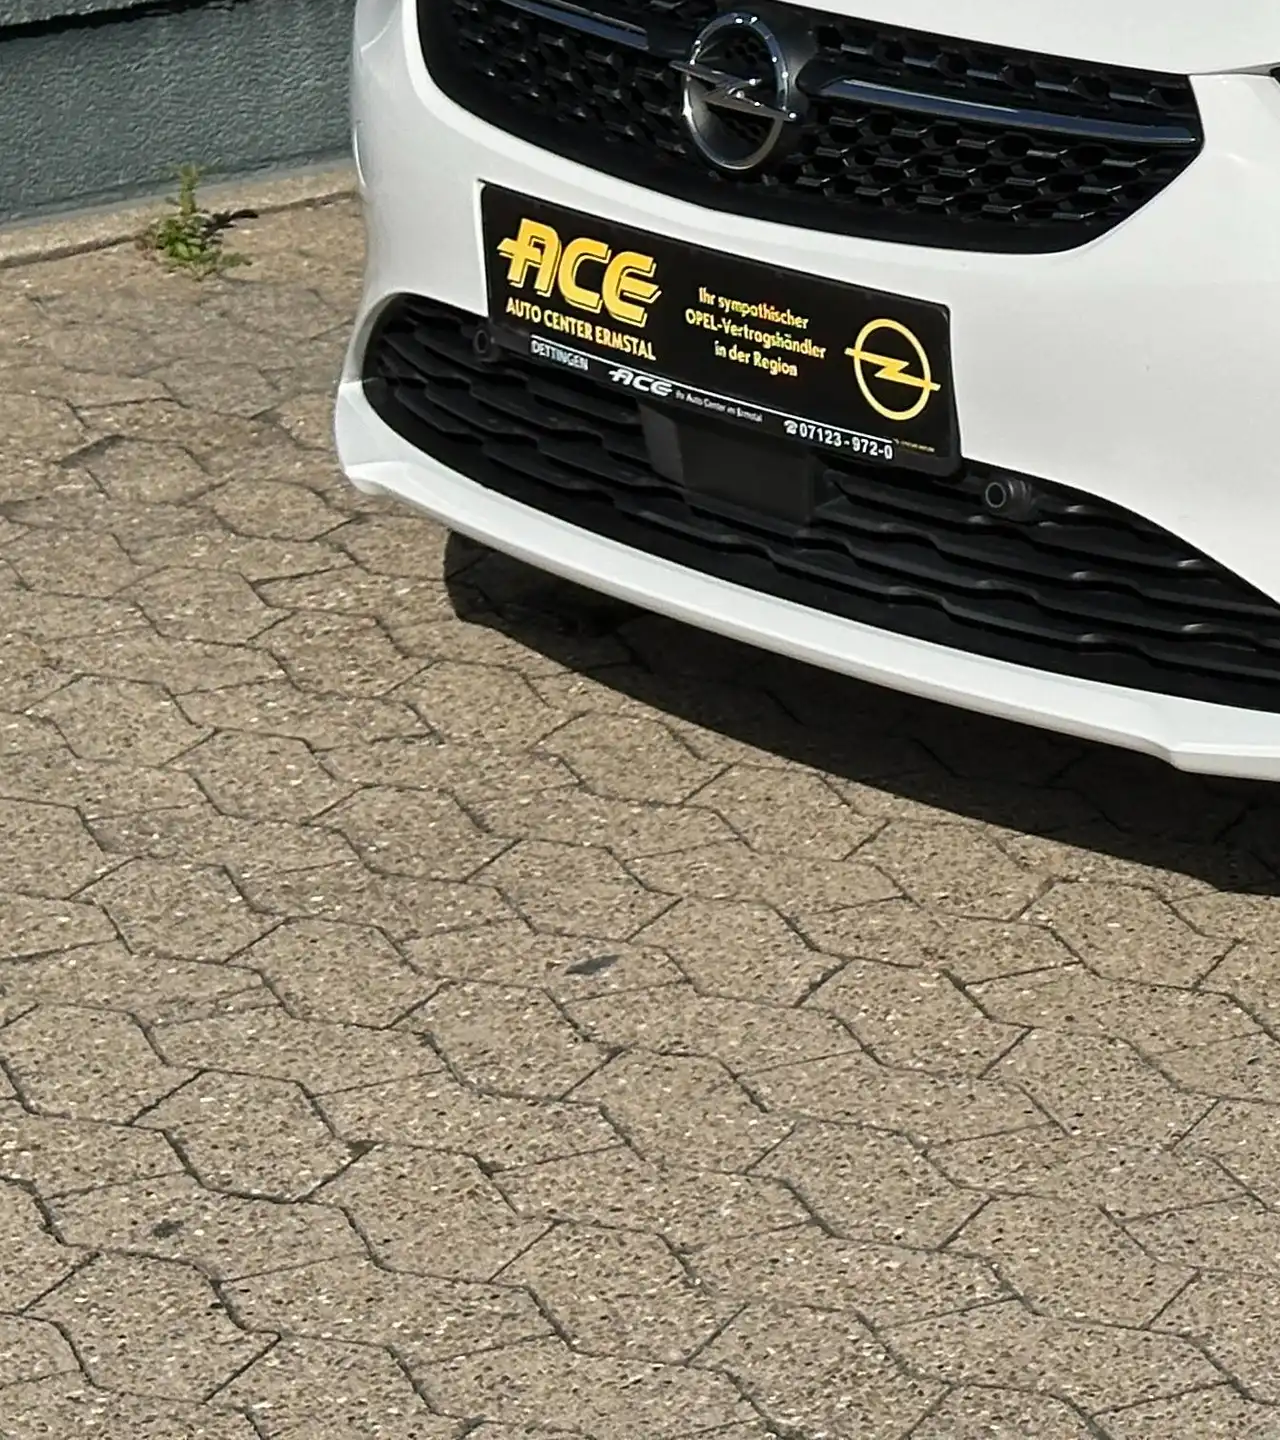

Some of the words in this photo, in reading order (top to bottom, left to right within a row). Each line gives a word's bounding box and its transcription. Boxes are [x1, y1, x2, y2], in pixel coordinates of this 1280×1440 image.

[497, 218, 662, 328] ACE
[699, 287, 716, 306] Ihr
[718, 294, 809, 330] sympathischer
[506, 297, 542, 323] AUTO
[544, 309, 593, 341] CENTER
[595, 326, 657, 361] ERMSTAL
[531, 340, 589, 370] DETTINGEN
[714, 340, 726, 357] in
[728, 344, 751, 364] der
[753, 351, 798, 376] Region
[608, 368, 673, 397] ACE
